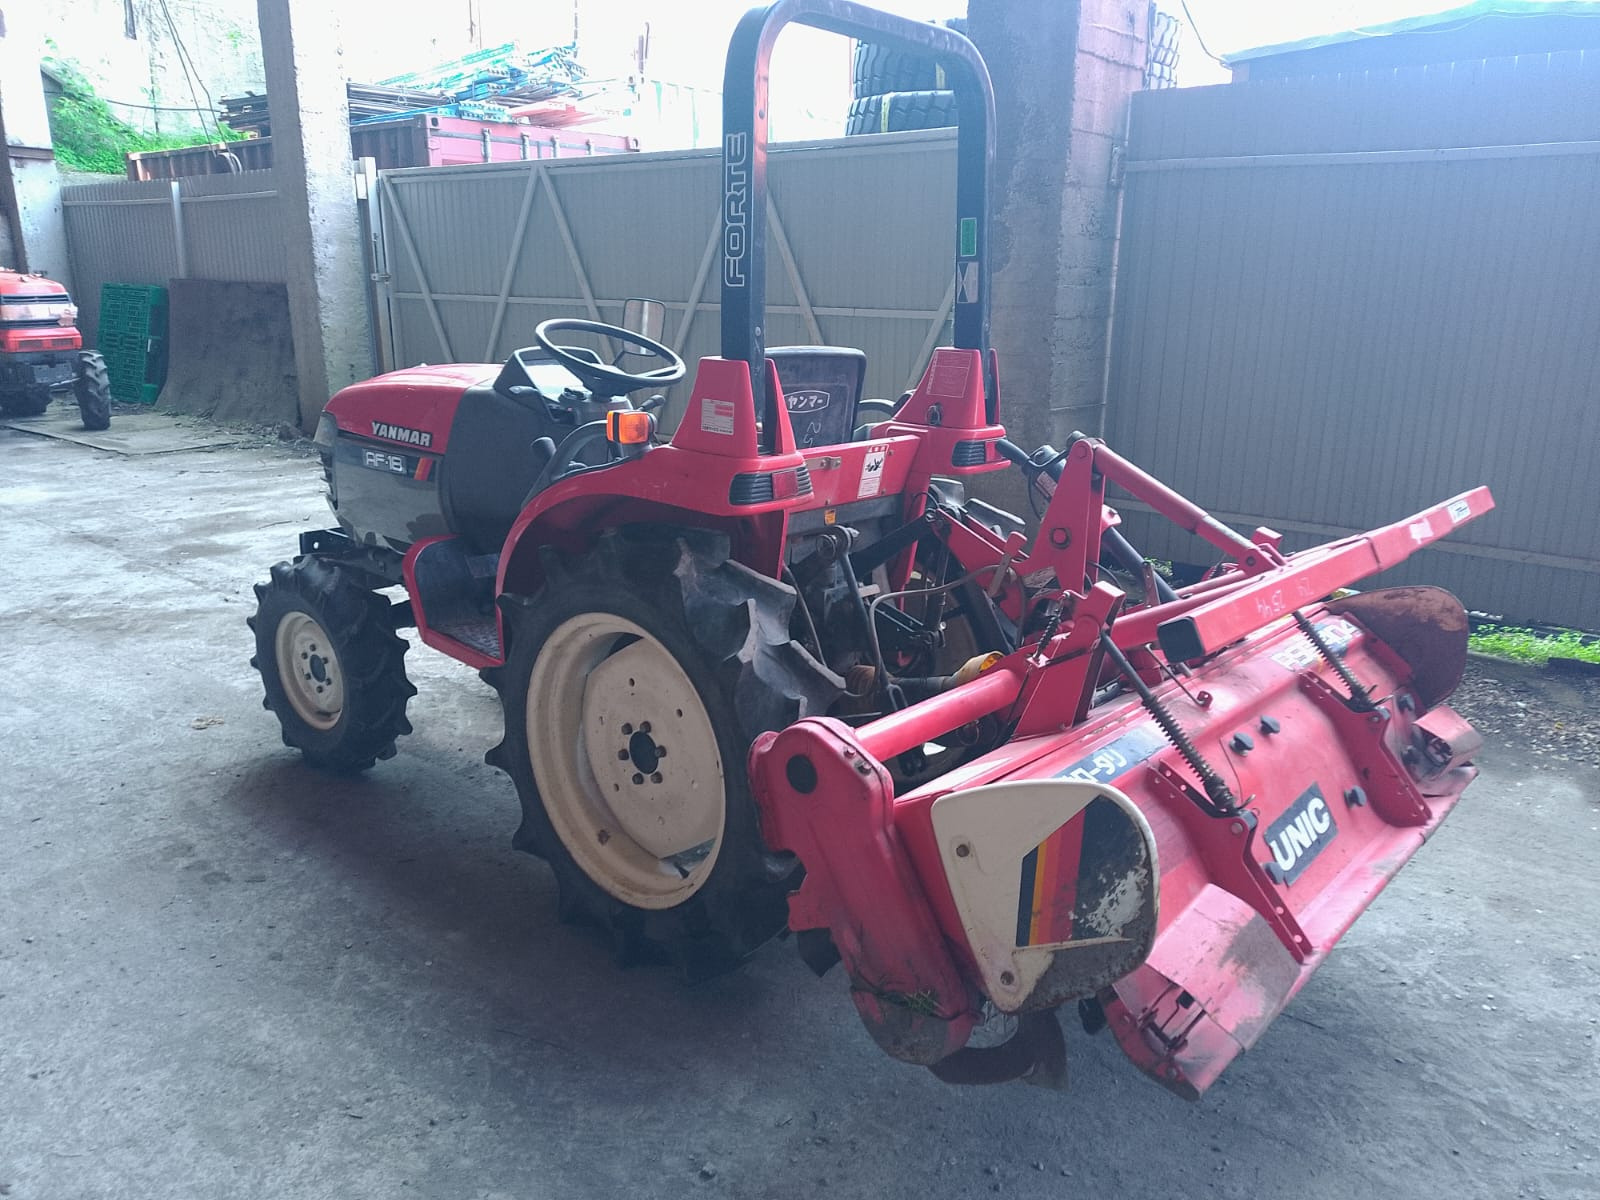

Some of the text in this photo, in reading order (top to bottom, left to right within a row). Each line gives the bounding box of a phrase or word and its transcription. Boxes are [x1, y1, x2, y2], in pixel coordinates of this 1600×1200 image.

[724, 131, 747, 287] FORTE
[788, 395, 823, 410] ヤンマー
[371, 421, 431, 447] YANMAR
[1268, 797, 1331, 872] UNIC
